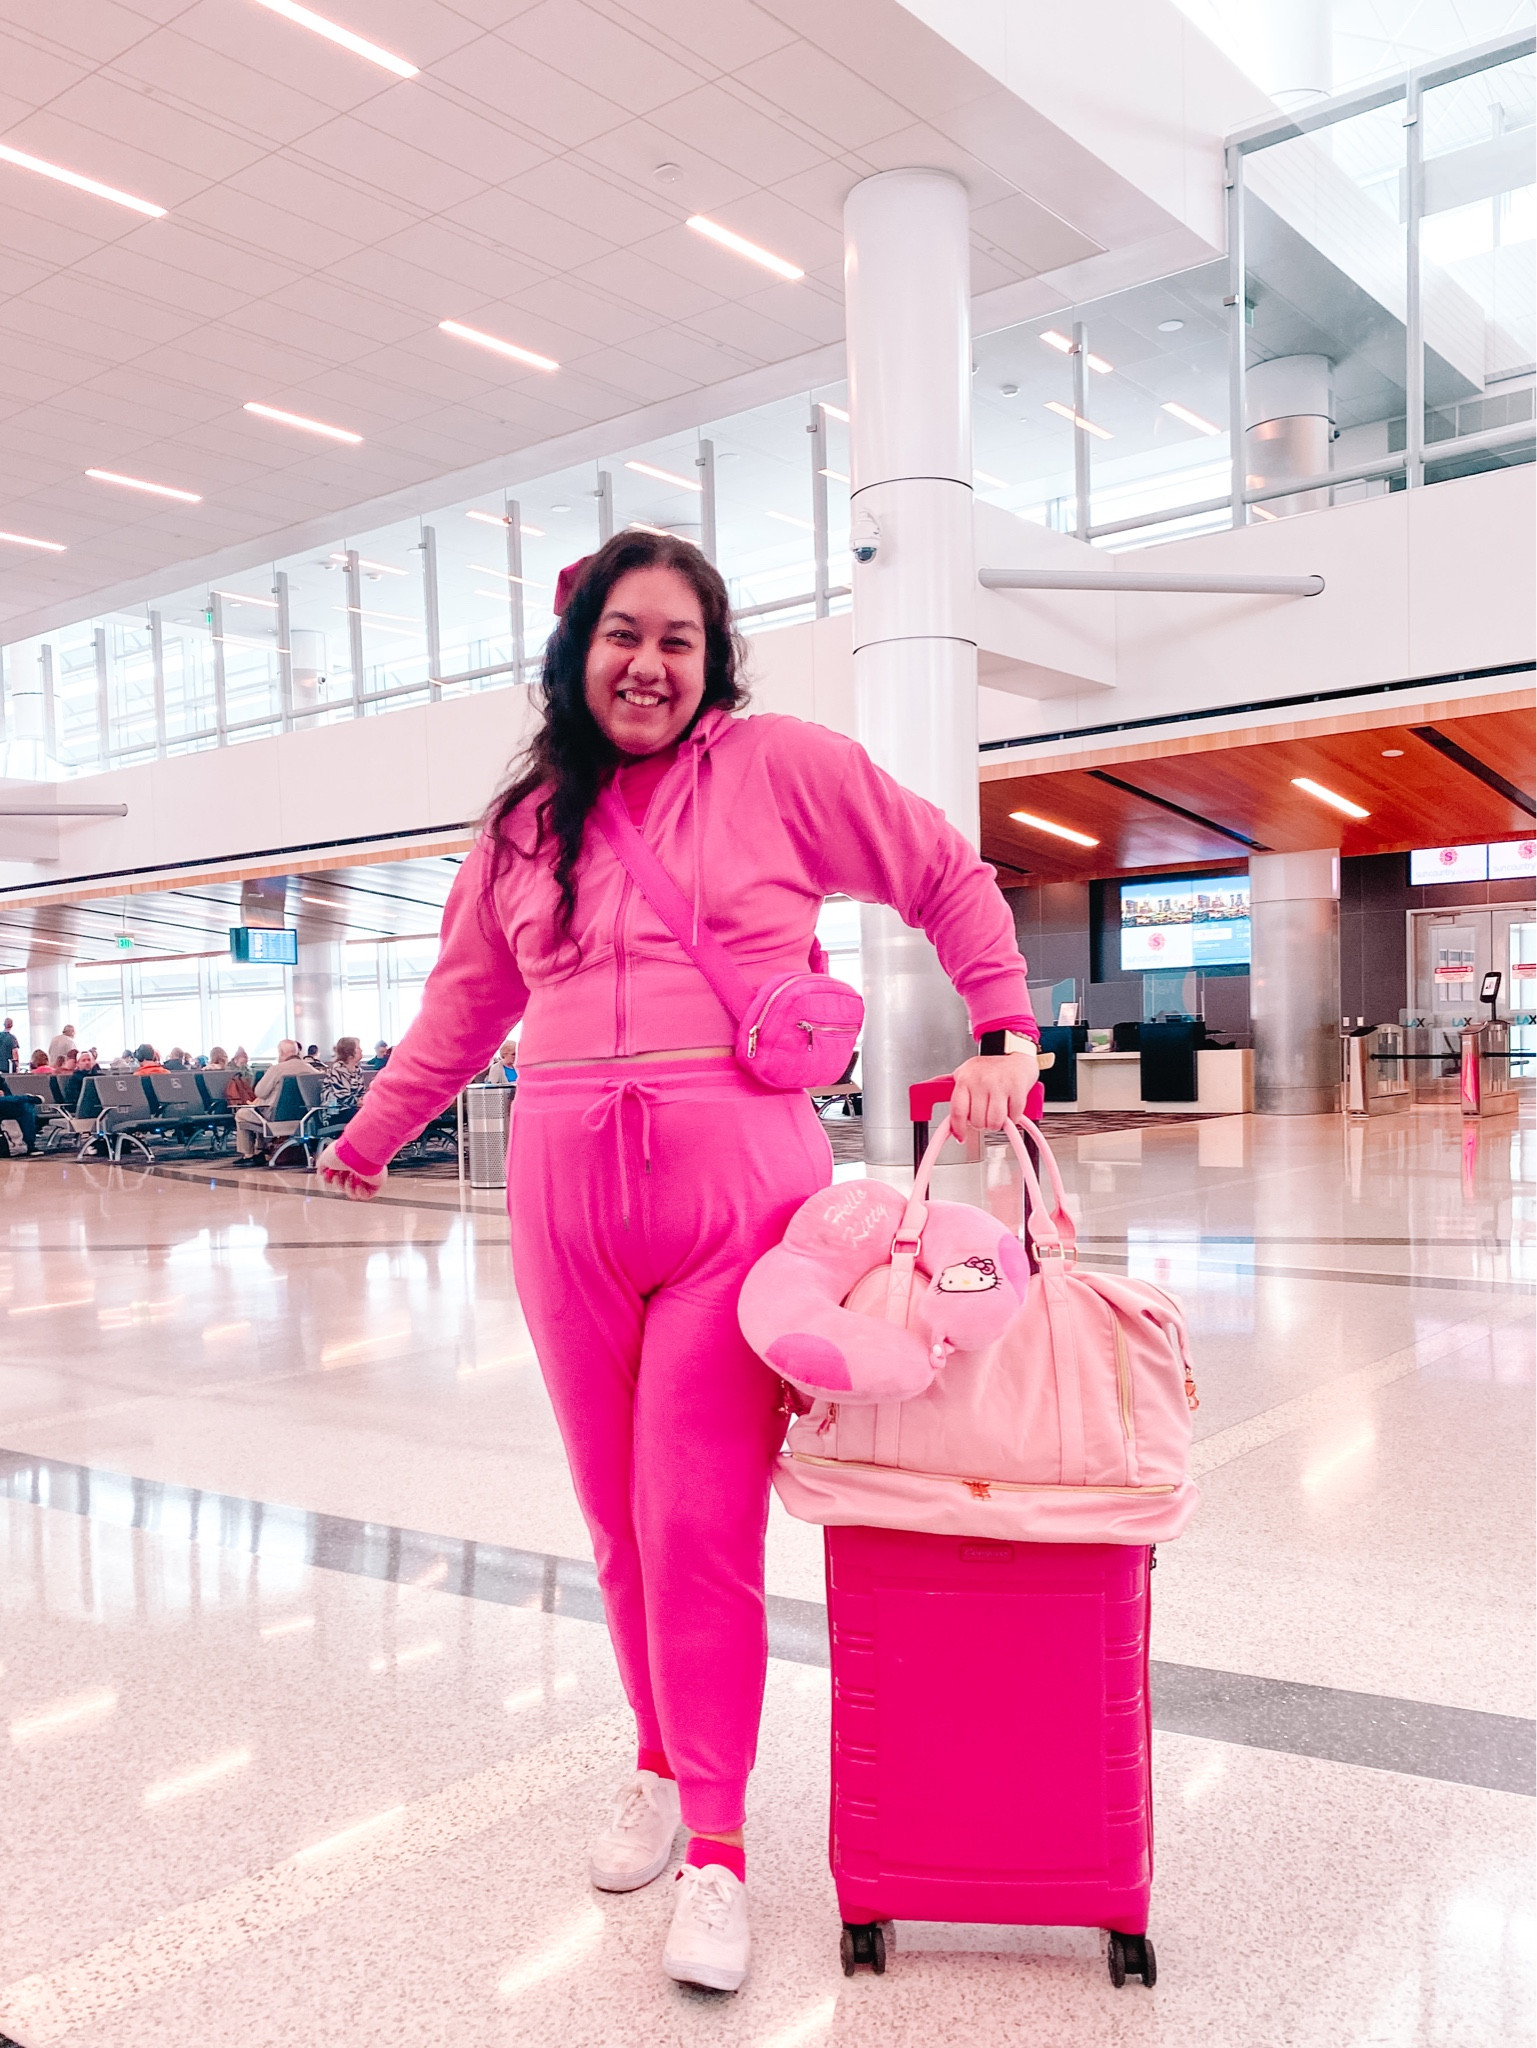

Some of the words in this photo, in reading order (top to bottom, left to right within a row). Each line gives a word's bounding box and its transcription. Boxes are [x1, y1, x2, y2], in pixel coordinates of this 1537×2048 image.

[1444, 851, 1453, 861] S
[1406, 1017, 1426, 1028] LAX
[1452, 1017, 1472, 1027] LAX
[1516, 1014, 1537, 1025] LAX
[823, 1189, 867, 1224] Hello
[842, 1203, 890, 1249] Kitty
